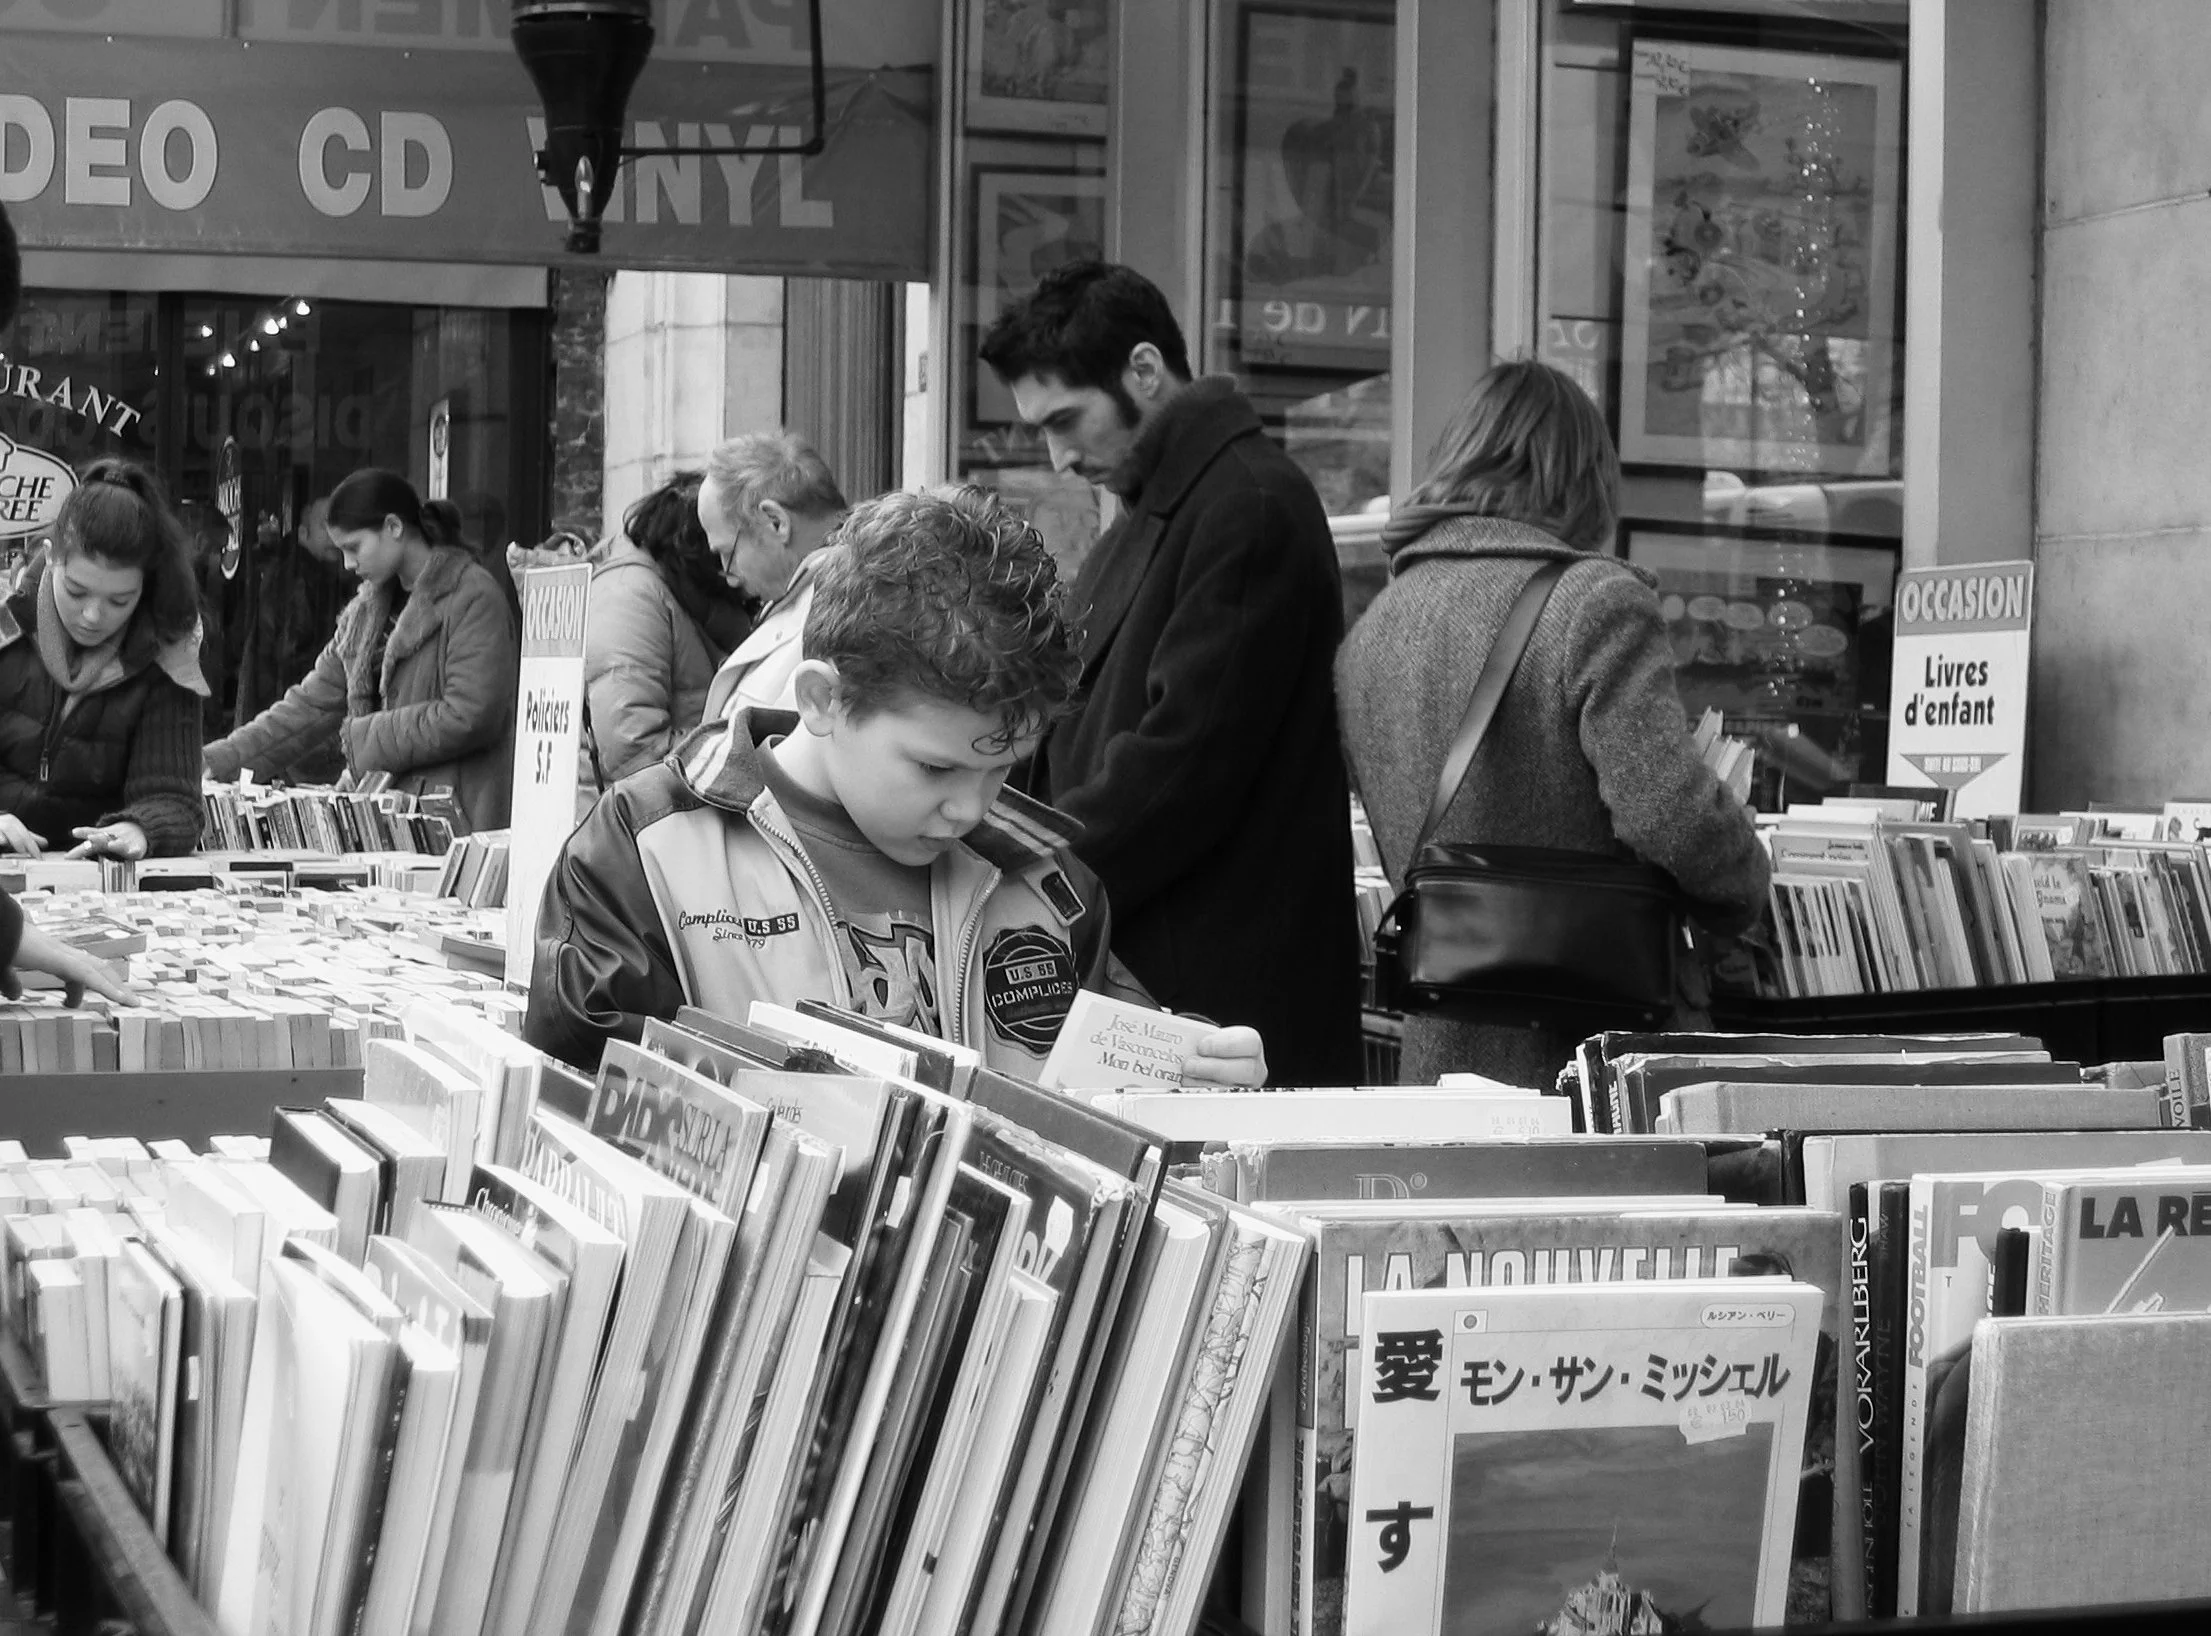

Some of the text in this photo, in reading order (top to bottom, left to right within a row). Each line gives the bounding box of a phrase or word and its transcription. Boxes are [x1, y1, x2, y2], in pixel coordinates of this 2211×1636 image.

[298, 106, 453, 217] CD
[526, 585, 584, 641] OCCASION
[1902, 575, 2024, 623] OCCASION
[1925, 654, 1989, 688] Livres
[525, 688, 570, 734] Policiers
[1904, 692, 1995, 726] d'enfant
[536, 740, 552, 784] S.F
[712, 926, 743, 941] Since
[991, 981, 1073, 1008] COMPLICES
[1107, 1014, 1137, 1033] José
[1090, 1031, 1184, 1064] de Vasconcelos
[1097, 1051, 1129, 1071] Mon
[1132, 1059, 1154, 1077] bel
[2169, 1068, 2186, 1127] VOILE
[2080, 1195, 2144, 1239] LA
[2036, 1191, 2058, 1316] HERITAGE
[1908, 1204, 1929, 1369] FOOTBALL
[1850, 1216, 1875, 1454] VORARLBERG
